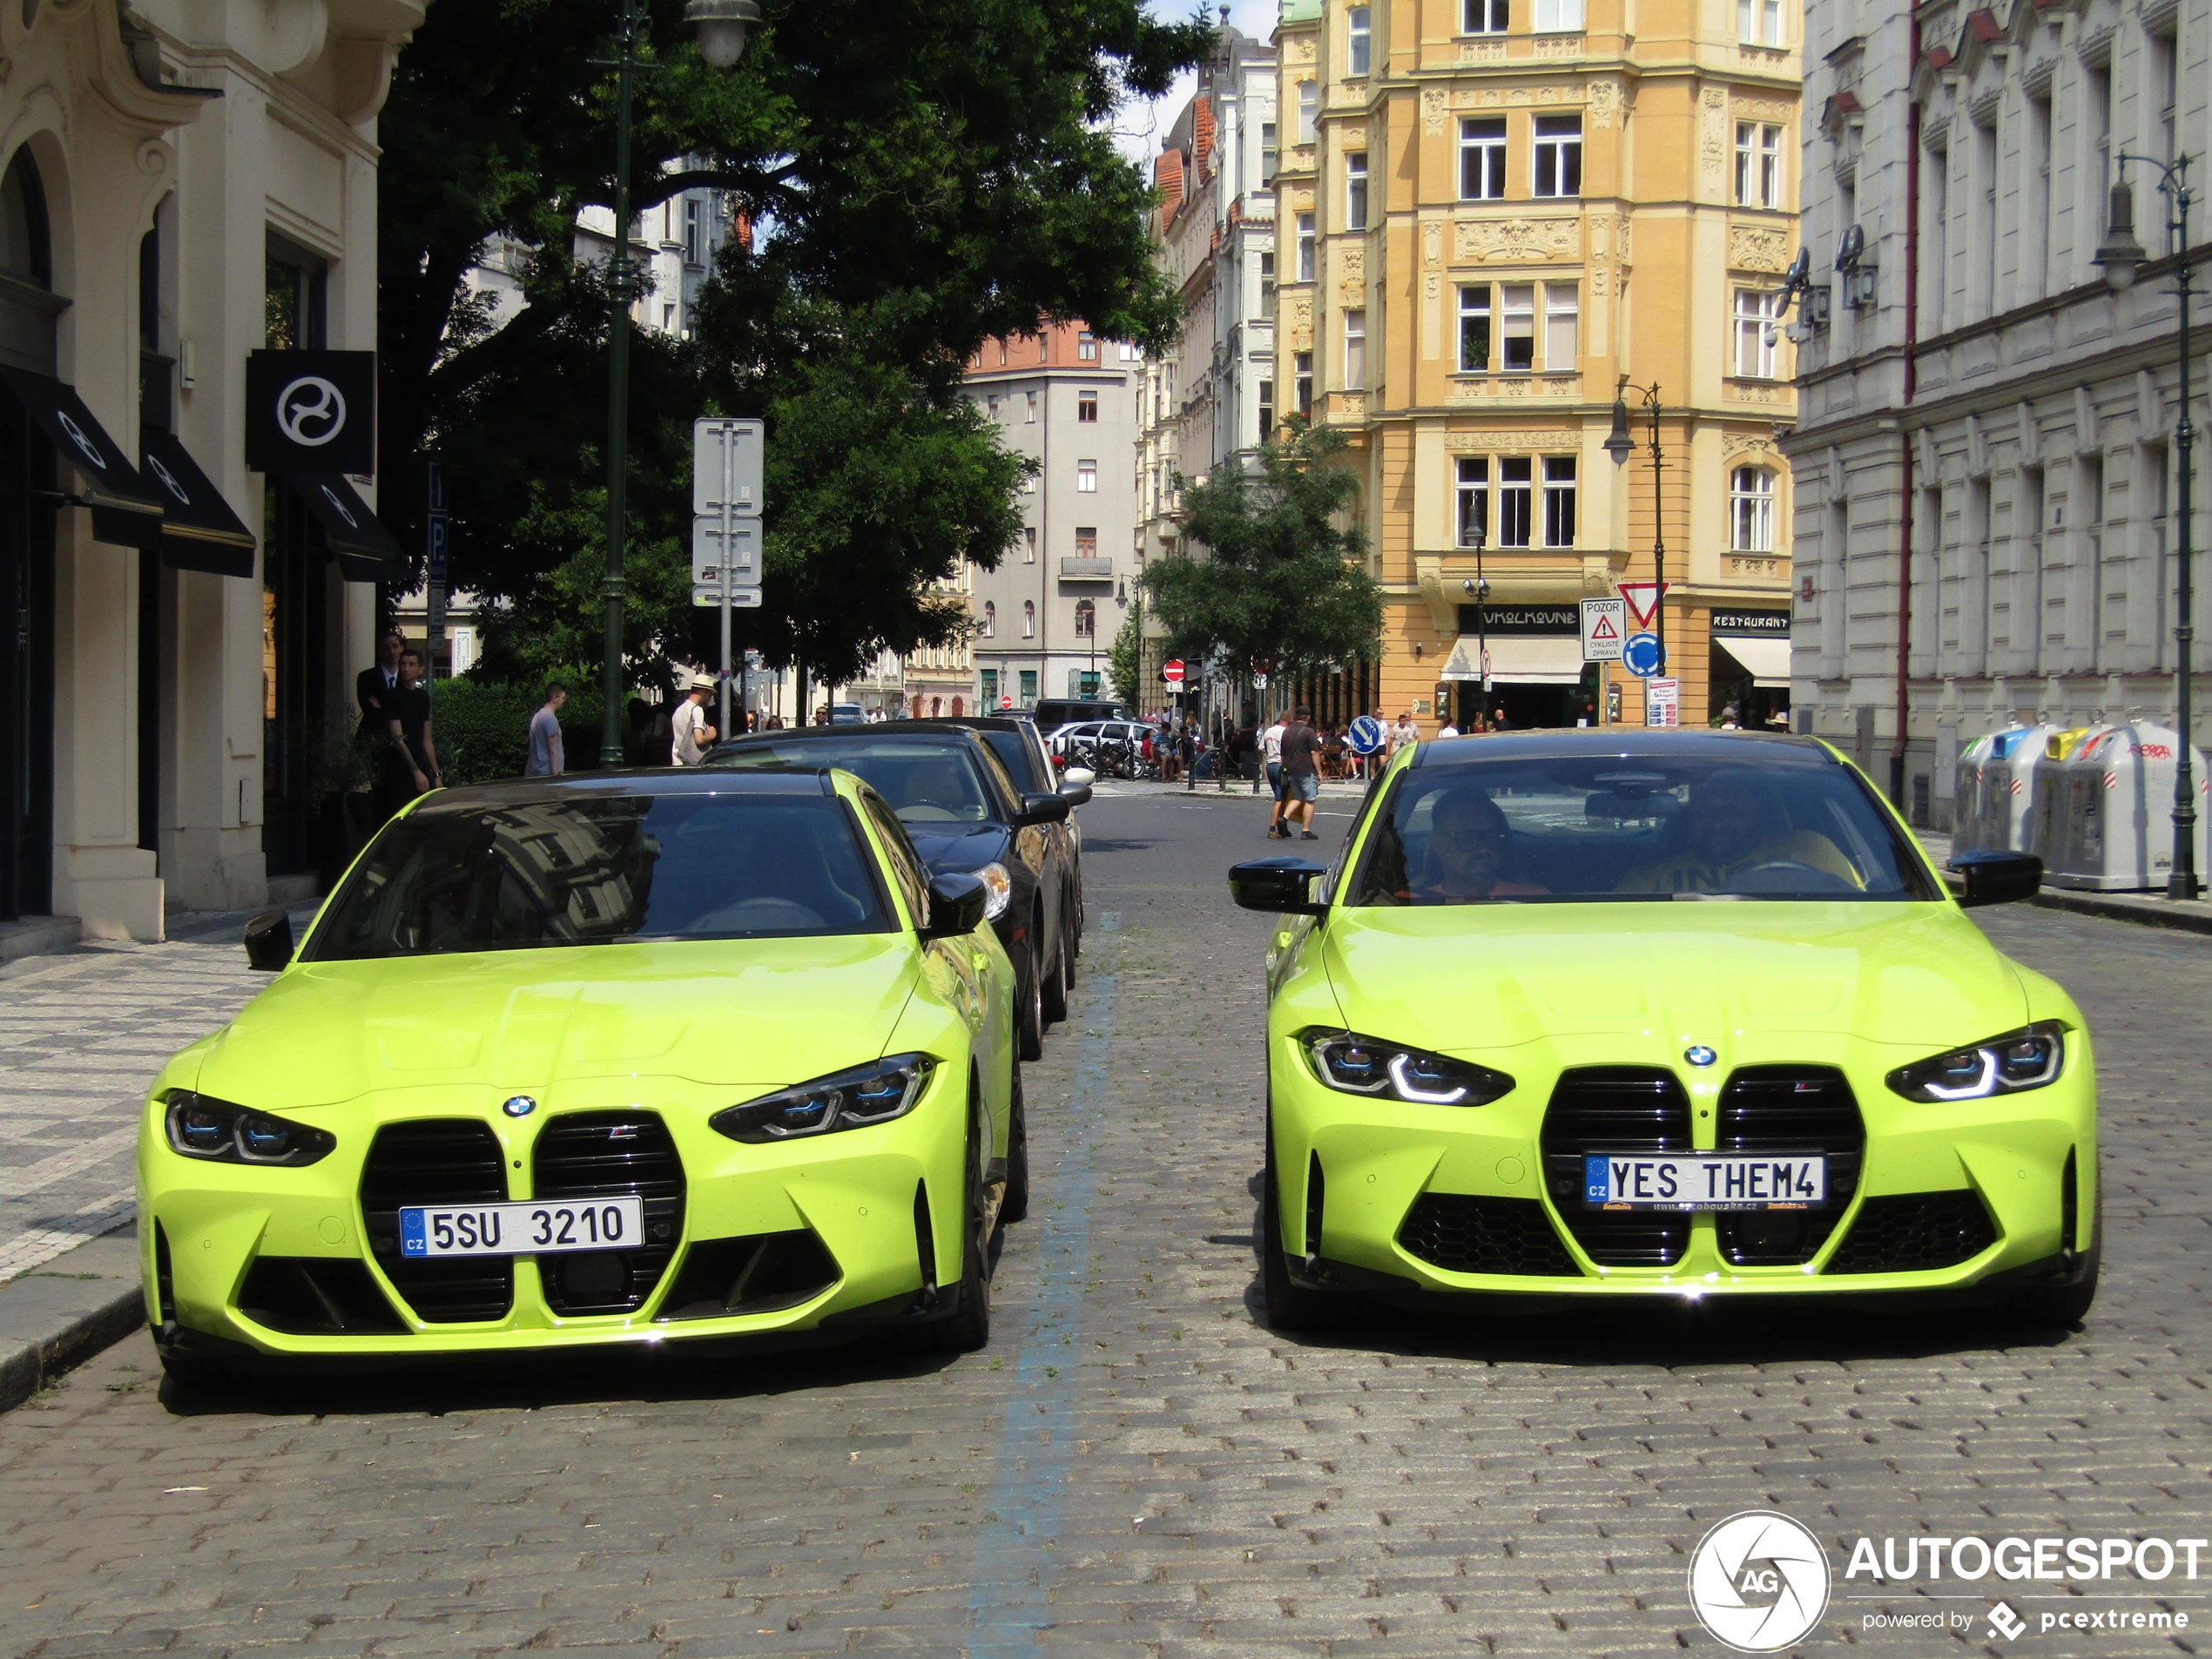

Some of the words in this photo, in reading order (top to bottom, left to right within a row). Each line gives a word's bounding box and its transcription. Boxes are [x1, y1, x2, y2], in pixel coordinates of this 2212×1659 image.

[1587, 603, 1620, 613] POZOR
[1713, 616, 1788, 628] RESTAURANT
[1611, 1162, 1678, 1198] YES
[1703, 1162, 1815, 1198] THEM4
[1588, 1185, 1606, 1197] CZ
[433, 1211, 502, 1250] 5SU
[531, 1204, 624, 1245] 3210
[407, 1239, 424, 1250] CZ
